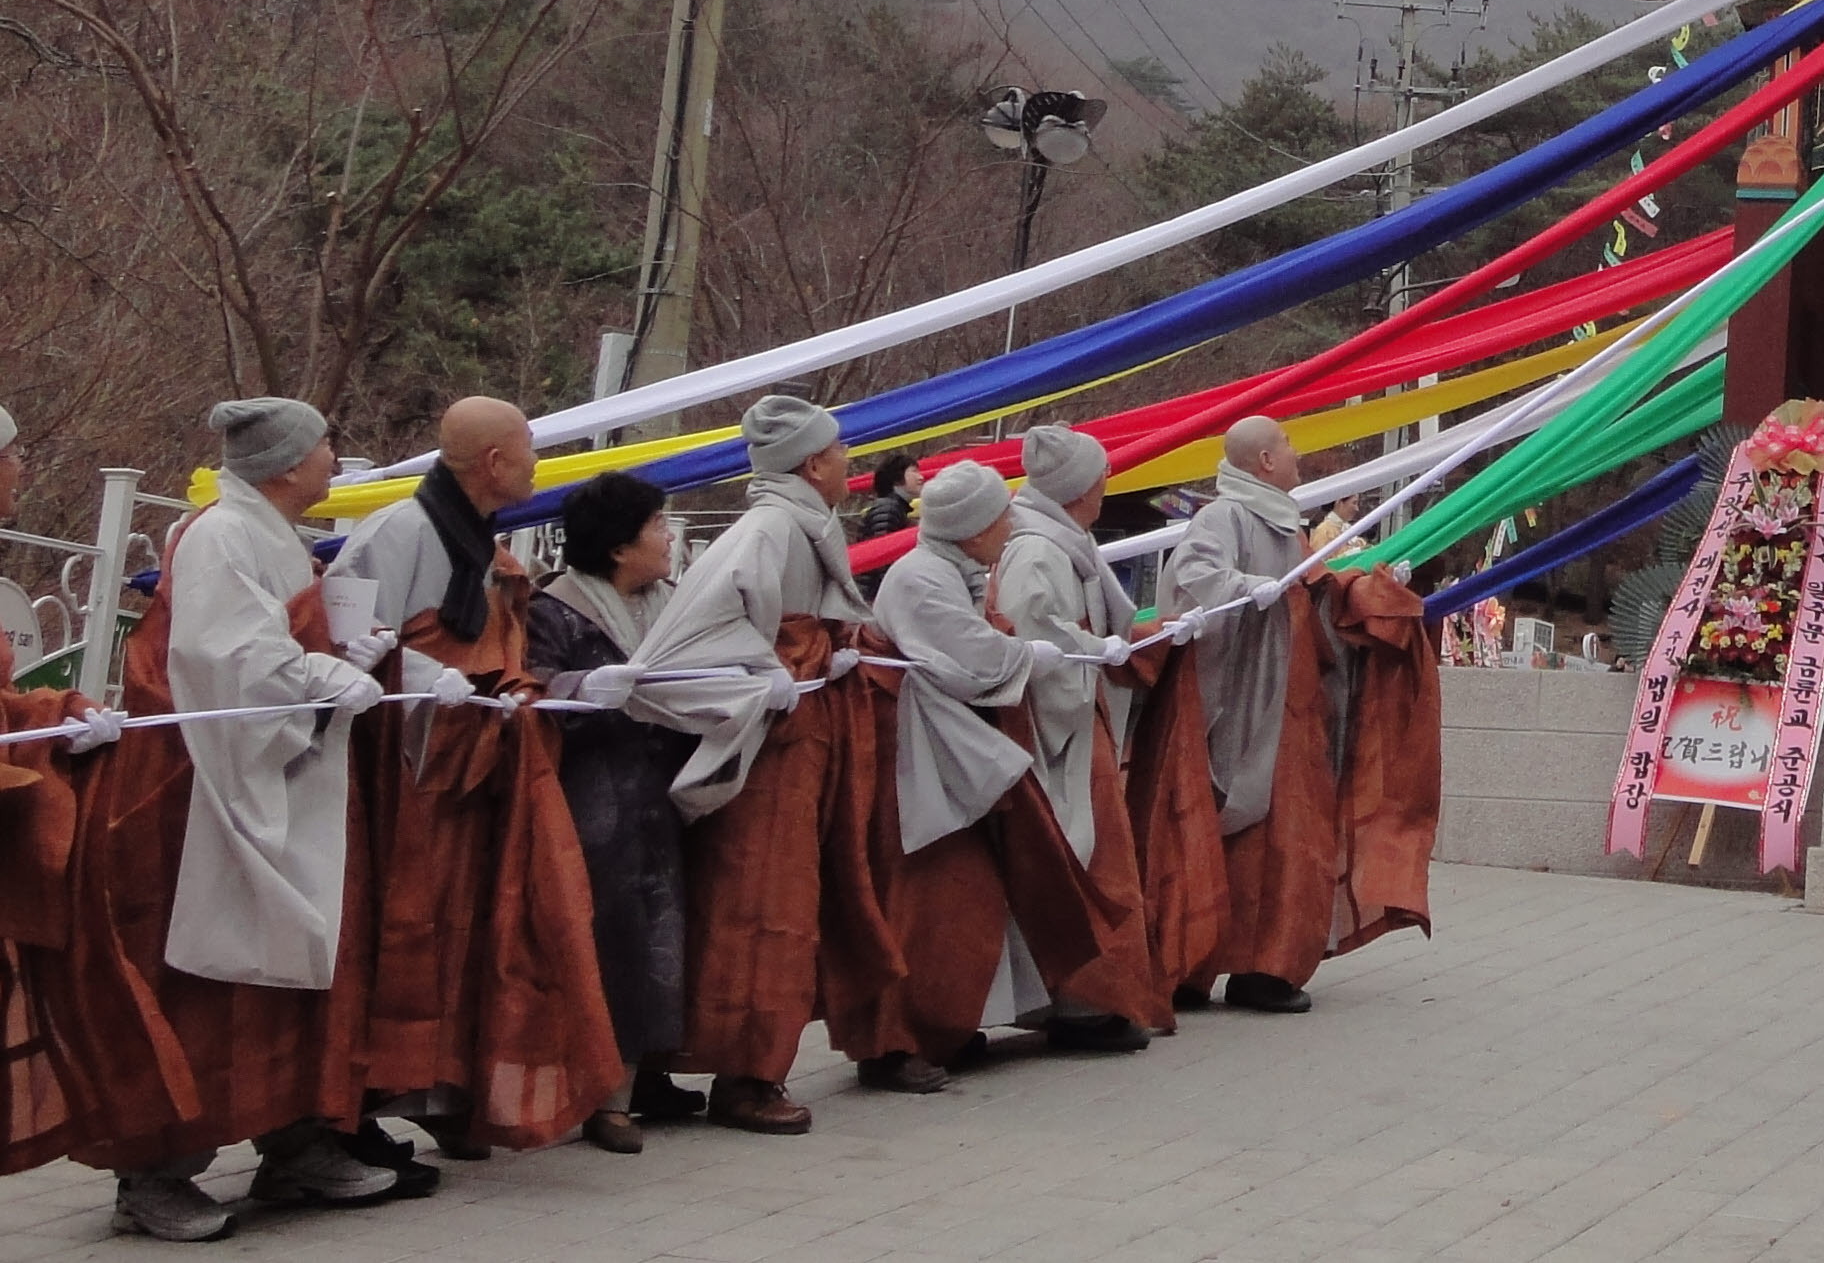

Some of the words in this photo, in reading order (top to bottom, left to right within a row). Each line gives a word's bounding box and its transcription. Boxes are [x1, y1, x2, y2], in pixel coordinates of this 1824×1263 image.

[1675, 550, 1719, 619] 대전사
[1711, 703, 1743, 732] 祝
[1783, 655, 1822, 730] 금륜교
[1619, 750, 1655, 810] 합장
[1769, 746, 1808, 824] 준공식
